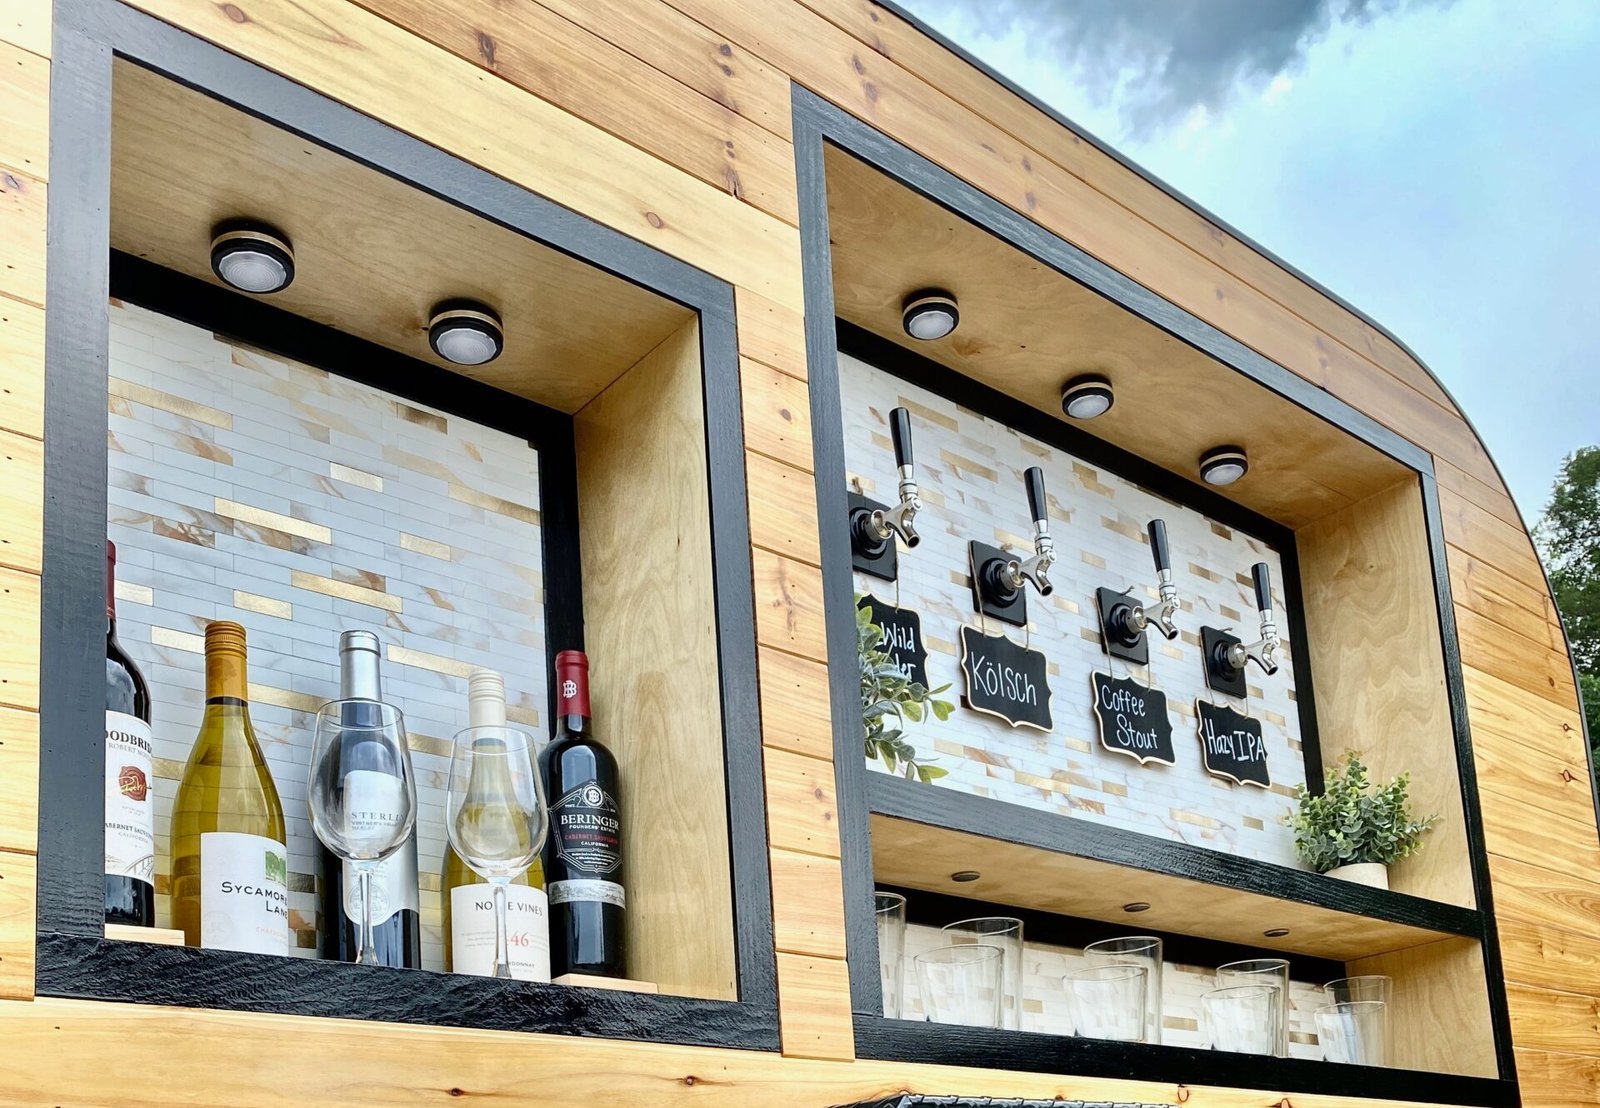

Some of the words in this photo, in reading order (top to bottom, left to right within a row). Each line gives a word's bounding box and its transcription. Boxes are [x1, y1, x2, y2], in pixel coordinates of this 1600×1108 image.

[881, 621, 916, 653] Wild
[970, 651, 1038, 706] Kölsch
[1101, 684, 1146, 717] Coffee
[1116, 714, 1158, 750] Stout
[1204, 718, 1236, 760] Hazy
[1233, 730, 1267, 763] IPA
[561, 814, 620, 831] BERINGER
[475, 901, 514, 911] NOE
[517, 901, 543, 917] VINES
[506, 929, 529, 948] 46
